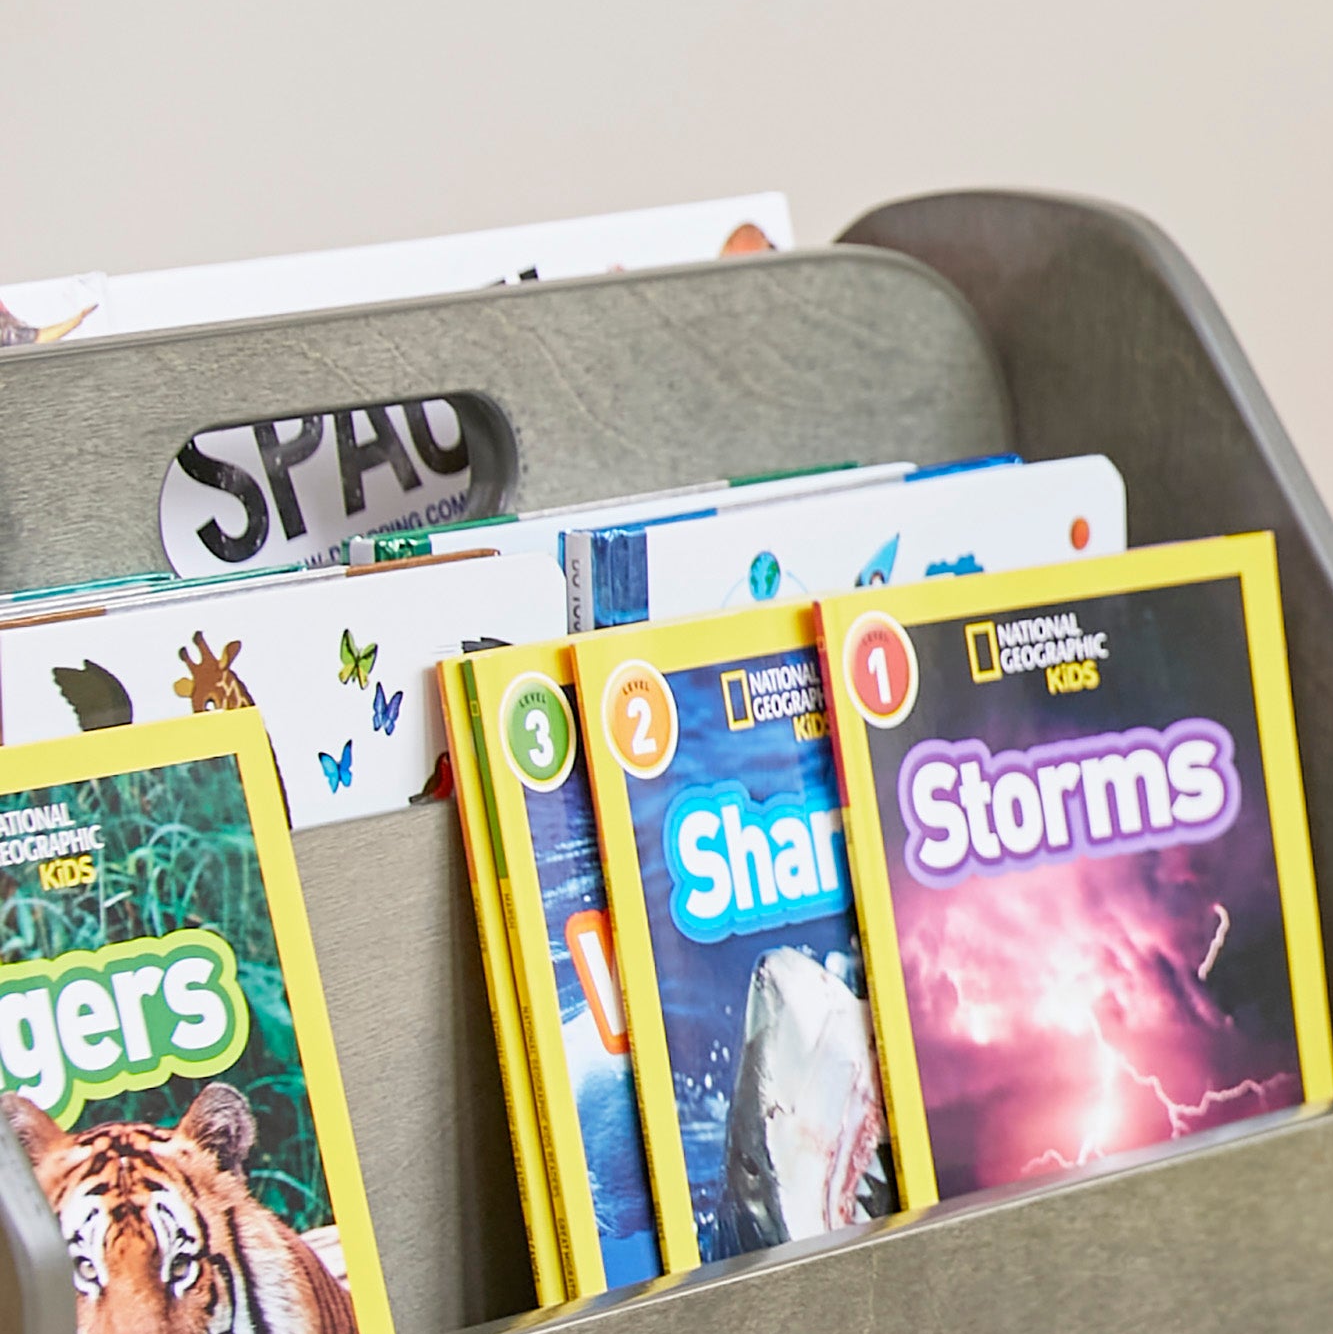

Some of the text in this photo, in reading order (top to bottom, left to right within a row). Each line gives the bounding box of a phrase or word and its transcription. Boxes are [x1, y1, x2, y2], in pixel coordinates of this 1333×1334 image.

[997, 613, 1082, 647] NATIONAL
[1000, 633, 1109, 674] GEOGRAPHIC
[518, 692, 547, 708] LEVEL
[622, 680, 650, 696] LEVEL
[748, 662, 820, 696] NATIONAL
[867, 647, 892, 704] 1
[525, 709, 555, 768] 3
[626, 696, 657, 754] 2
[910, 738, 1222, 870] Storms
[0, 957, 228, 1111] gers
